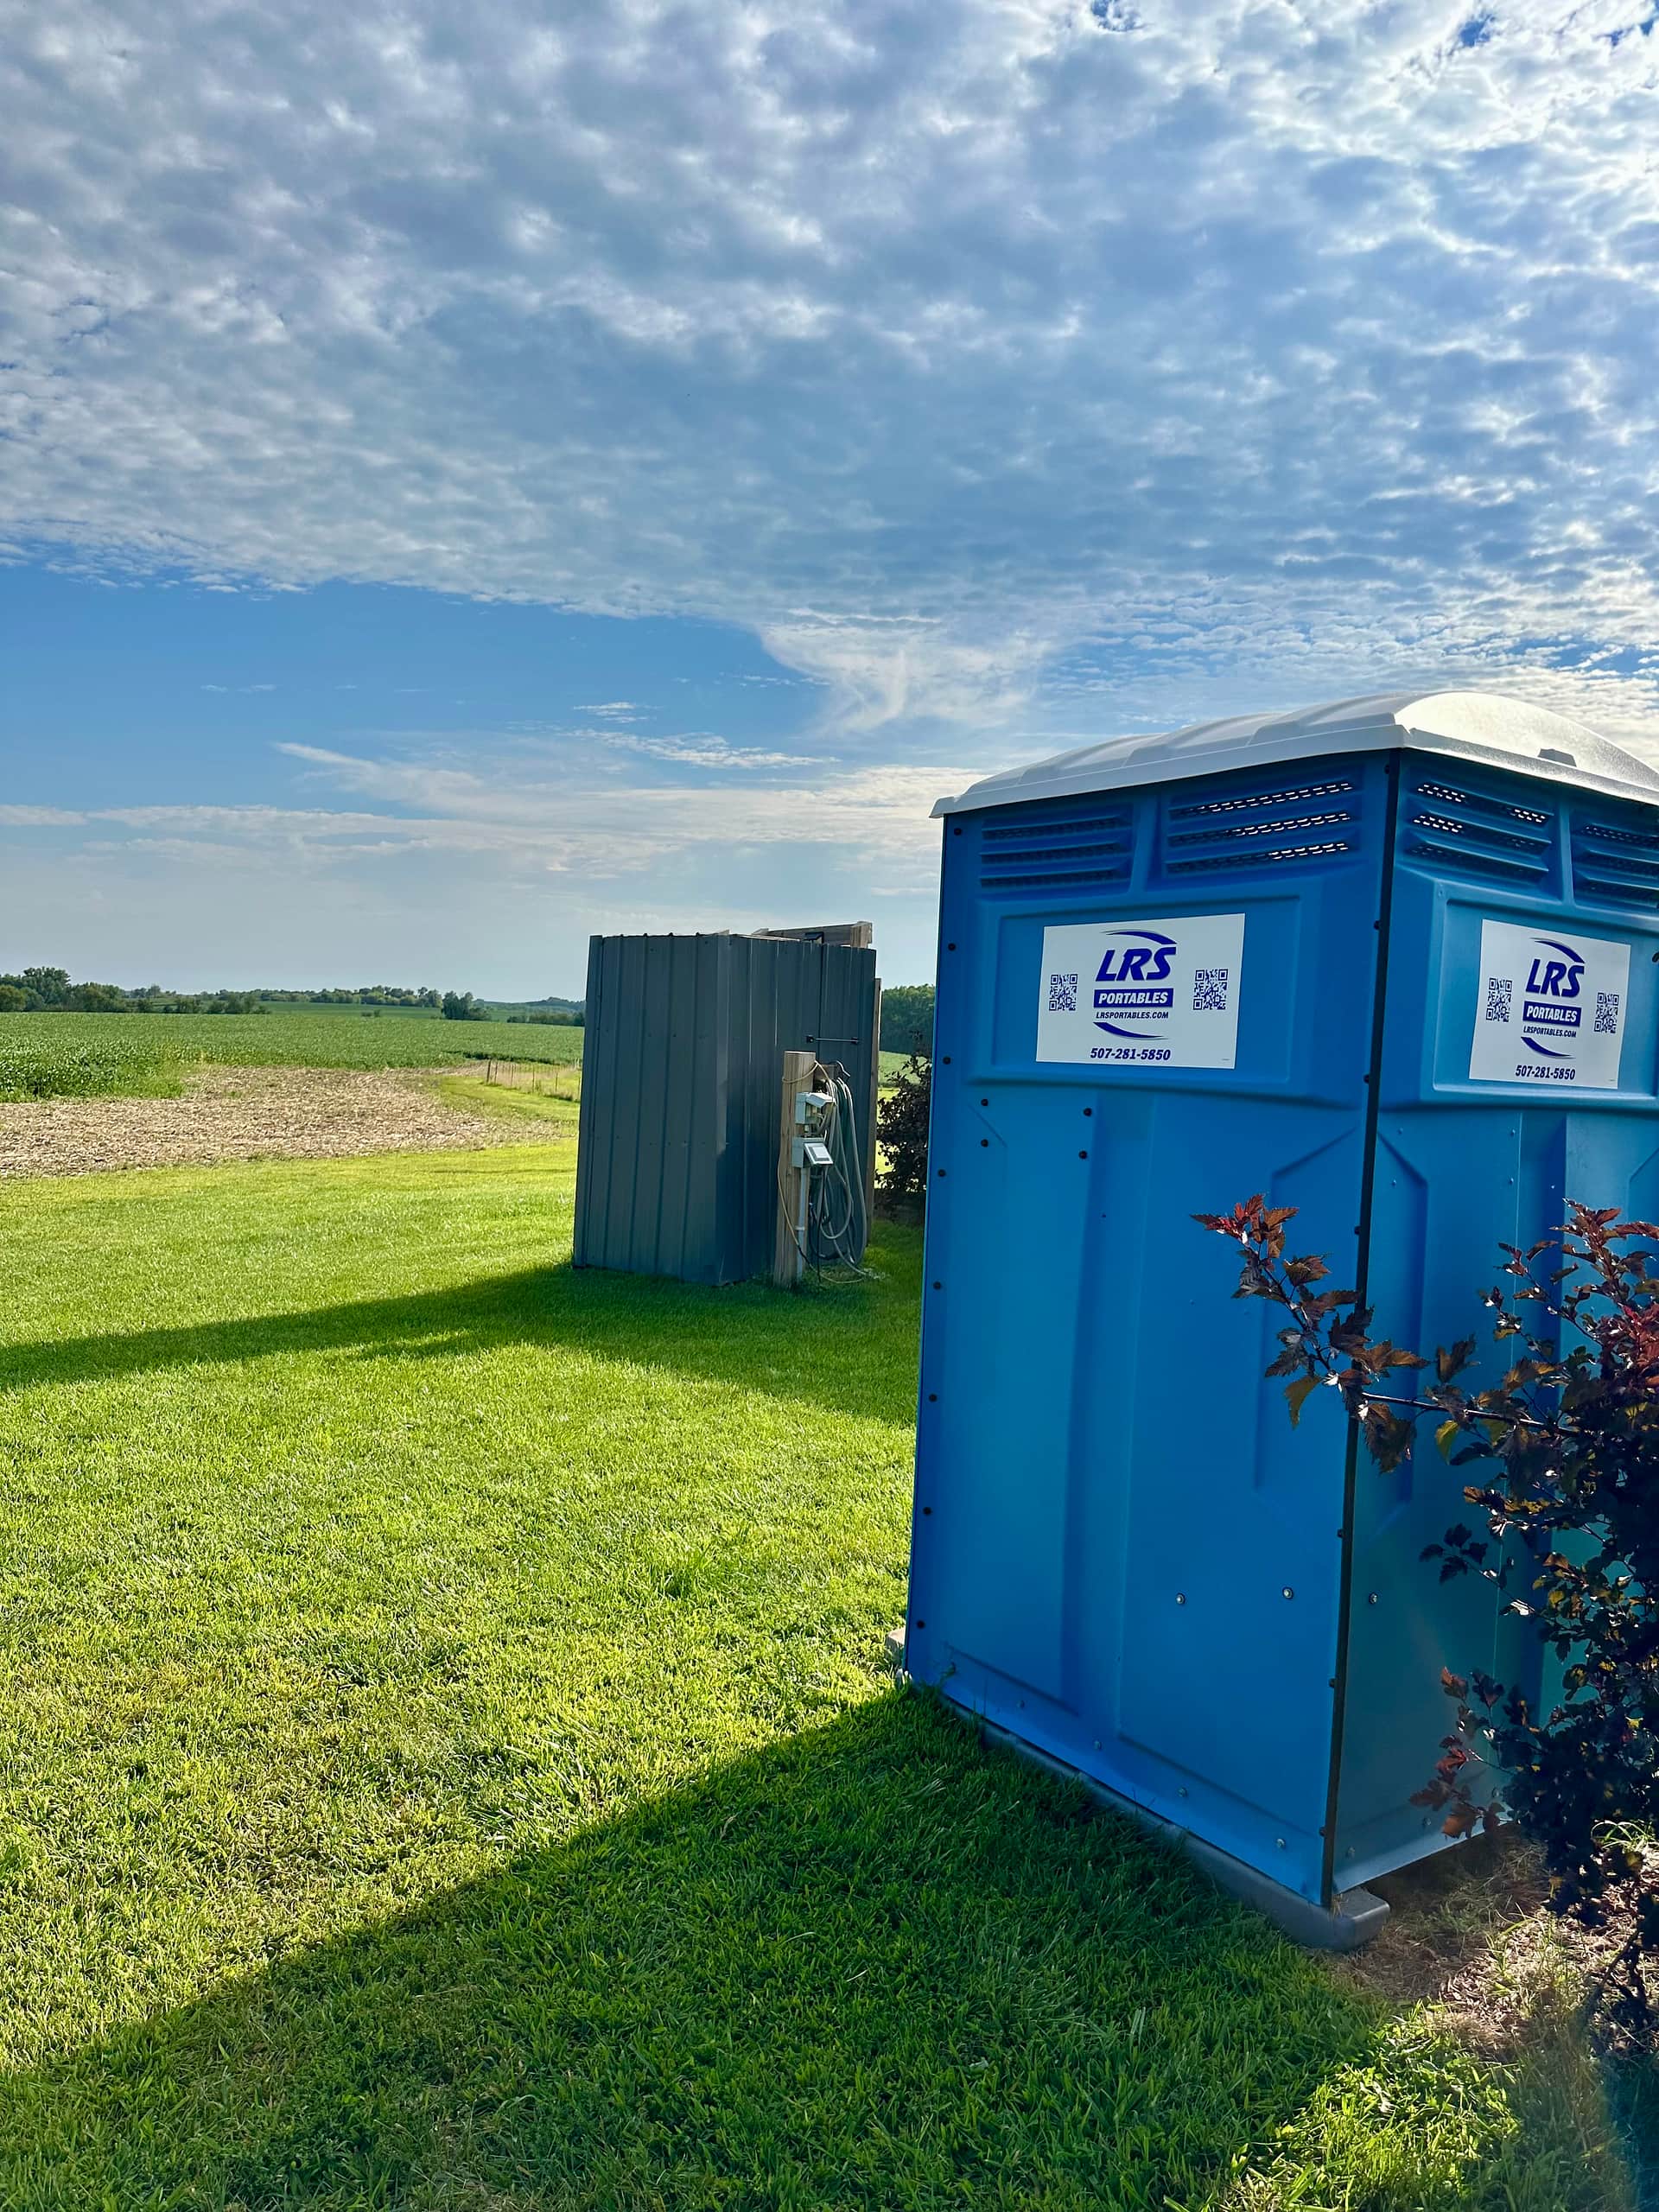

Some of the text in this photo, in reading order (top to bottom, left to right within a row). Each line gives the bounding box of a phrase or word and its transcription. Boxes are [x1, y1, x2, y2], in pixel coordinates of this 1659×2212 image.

[1096, 946, 1177, 982] LRS
[1525, 958, 1585, 998] LRS
[1098, 992, 1168, 1004] PORTABLES
[1526, 1006, 1578, 1022] PORTABLES
[1523, 1026, 1576, 1038] LRSPORTABLES.COM
[1090, 1047, 1171, 1061] 507-281-5850
[1516, 1065, 1575, 1080] 507-281-5850
